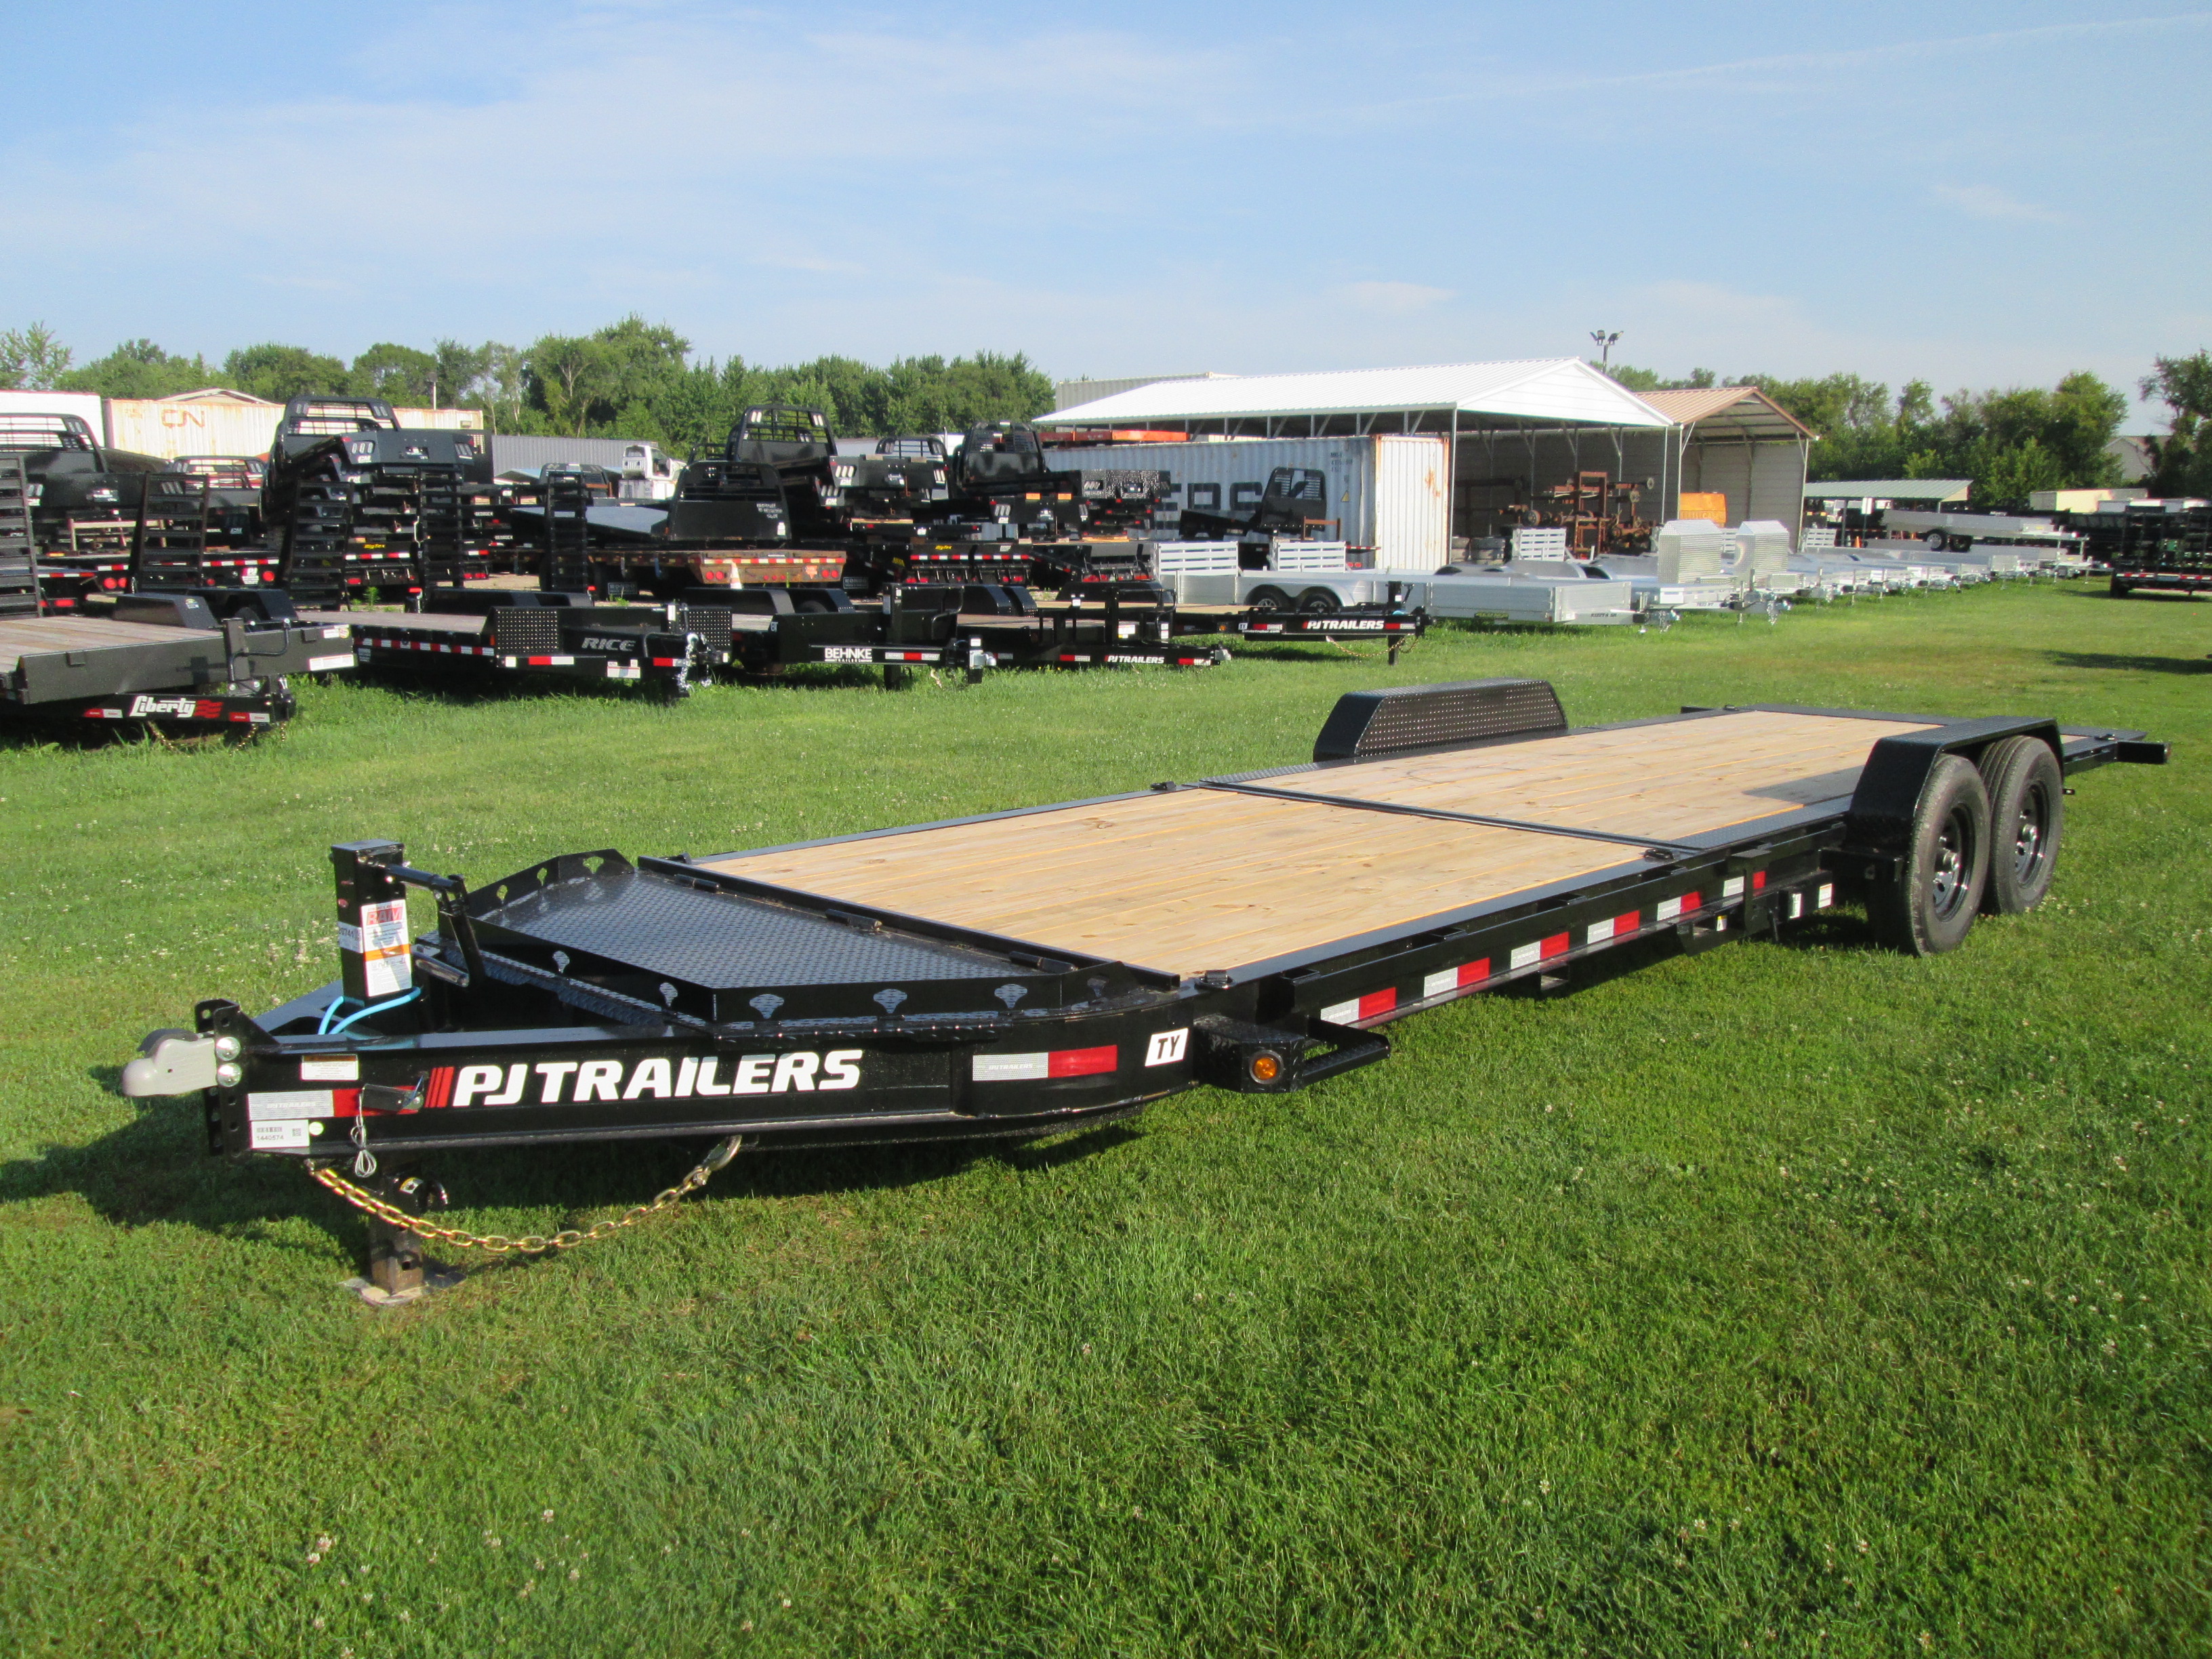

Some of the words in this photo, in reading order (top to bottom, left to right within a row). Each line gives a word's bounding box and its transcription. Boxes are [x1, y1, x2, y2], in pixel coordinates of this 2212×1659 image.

[162, 409, 205, 428] CN
[1322, 620, 1385, 629] TRAILERS
[581, 638, 636, 651] RICE
[825, 648, 872, 659] BEHNKE
[1119, 656, 1165, 664] TRAILERS
[129, 695, 196, 718] Liberty
[367, 907, 403, 925] RAM
[1158, 1035, 1181, 1059] TY
[453, 1064, 527, 1107] PJ
[535, 1050, 863, 1103] TRAILERS
